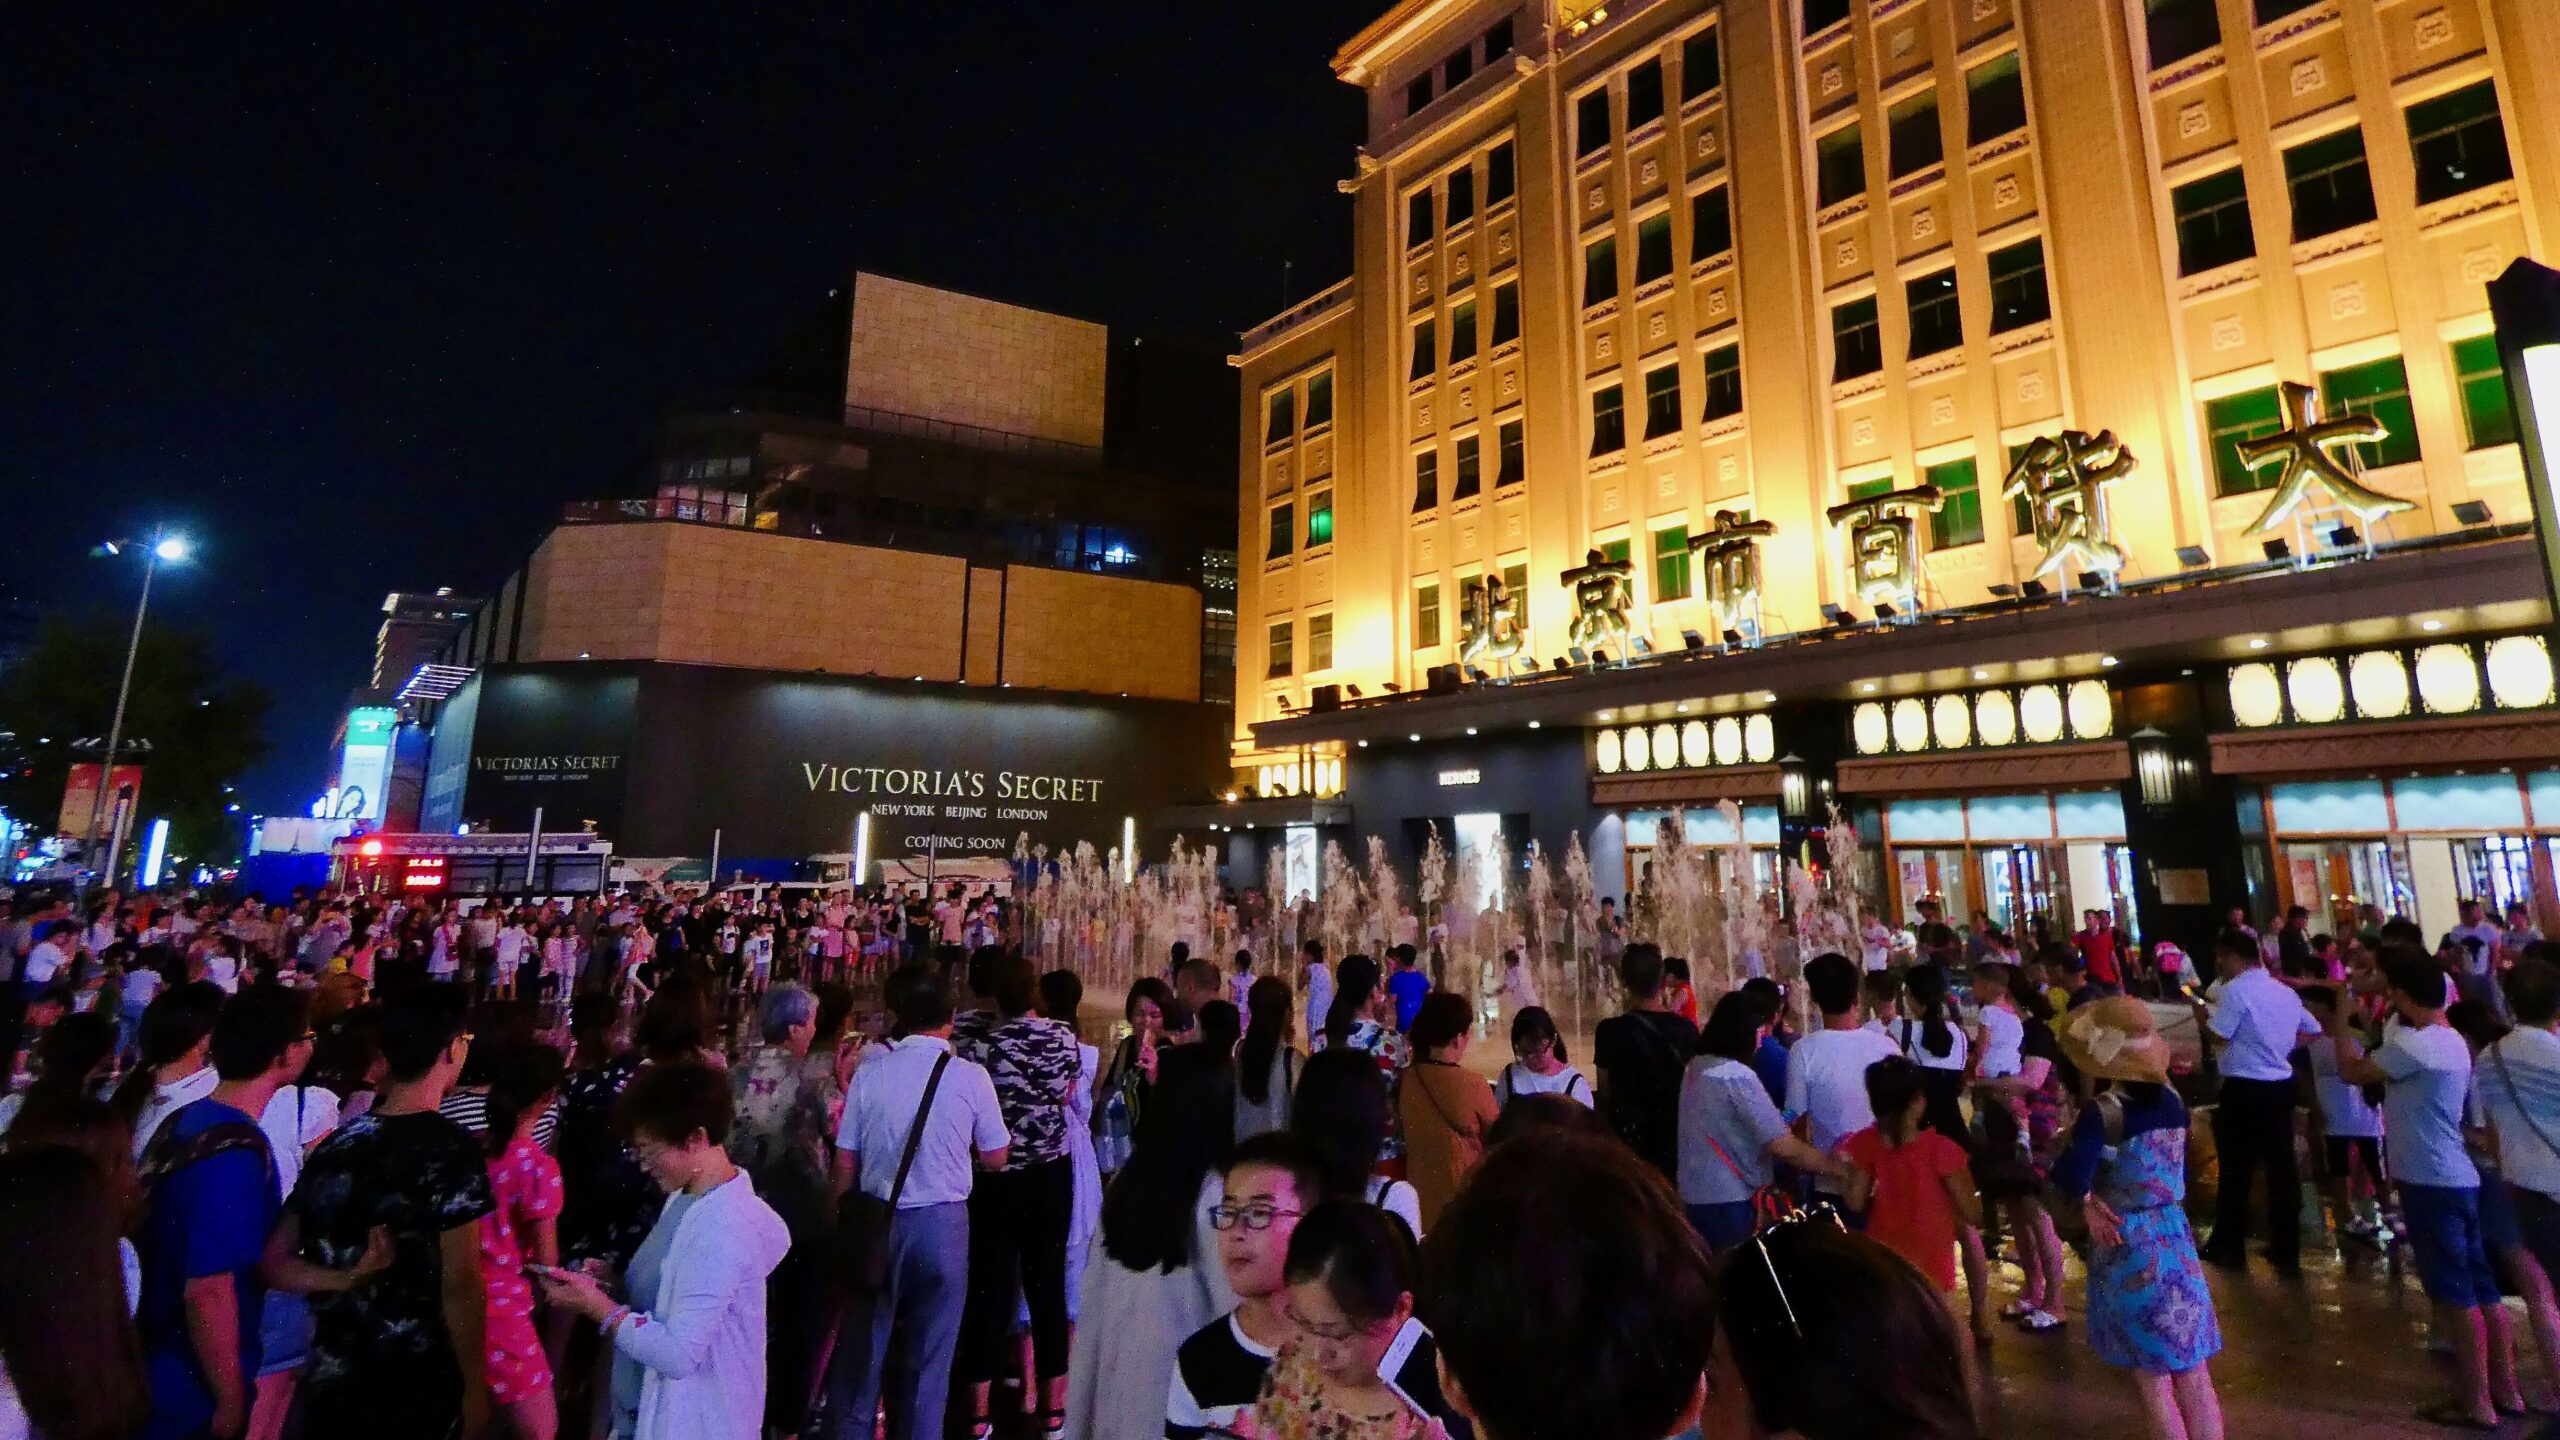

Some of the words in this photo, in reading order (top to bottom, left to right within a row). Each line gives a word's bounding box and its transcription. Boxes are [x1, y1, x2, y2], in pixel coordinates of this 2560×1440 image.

[476, 755, 559, 771] VICTORIA'S
[563, 754, 620, 770] SECRET
[803, 762, 985, 798] VICTORIA'S
[997, 771, 1103, 802] SECRET
[871, 803, 901, 815] NEW
[903, 804, 935, 816] YORK
[945, 806, 987, 820] BEIJING
[997, 807, 1048, 820] LONDON
[967, 836, 1006, 849] SOON
